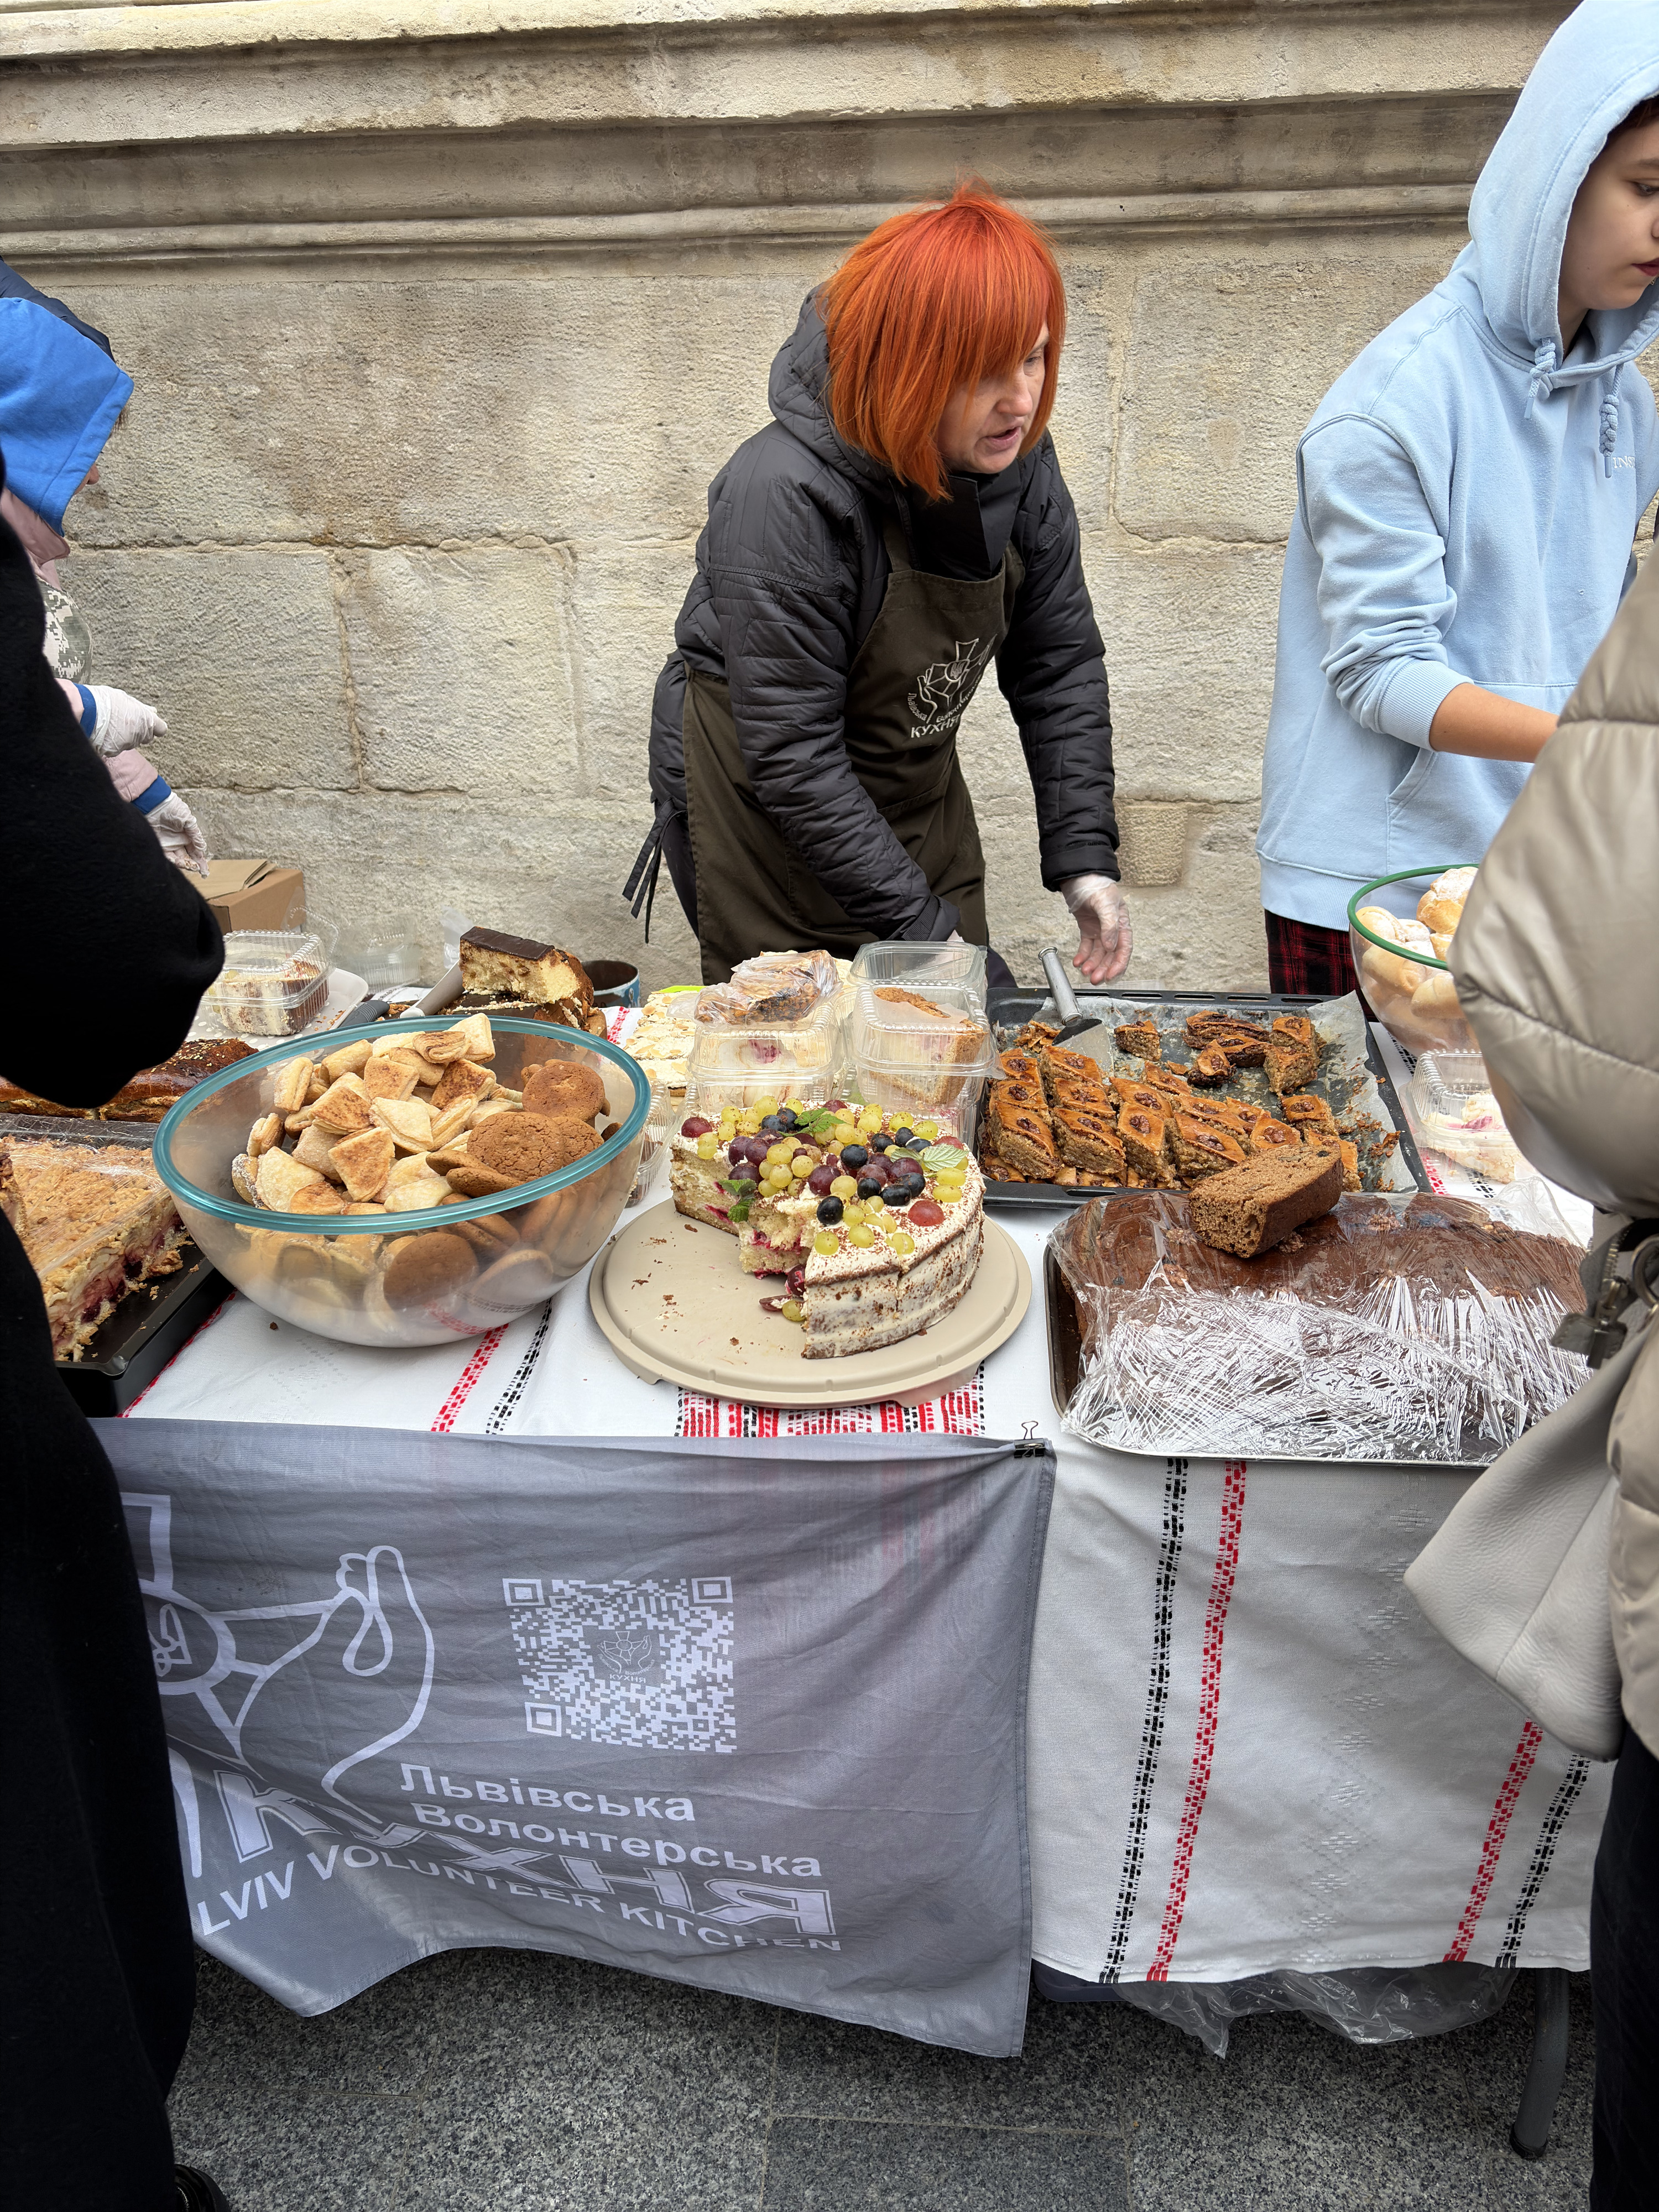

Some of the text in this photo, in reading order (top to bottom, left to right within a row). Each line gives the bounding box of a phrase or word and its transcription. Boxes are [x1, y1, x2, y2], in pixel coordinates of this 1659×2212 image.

[911, 714, 961, 738] КУХНЯ
[609, 1674, 646, 1683] КУХНЯ
[401, 1763, 695, 1821] Львівська
[214, 1770, 836, 1936] КУХНЯ
[411, 1802, 822, 1876] Волонтерська
[197, 1845, 841, 1952] LVIV VOLUNTEER KITCHEN
